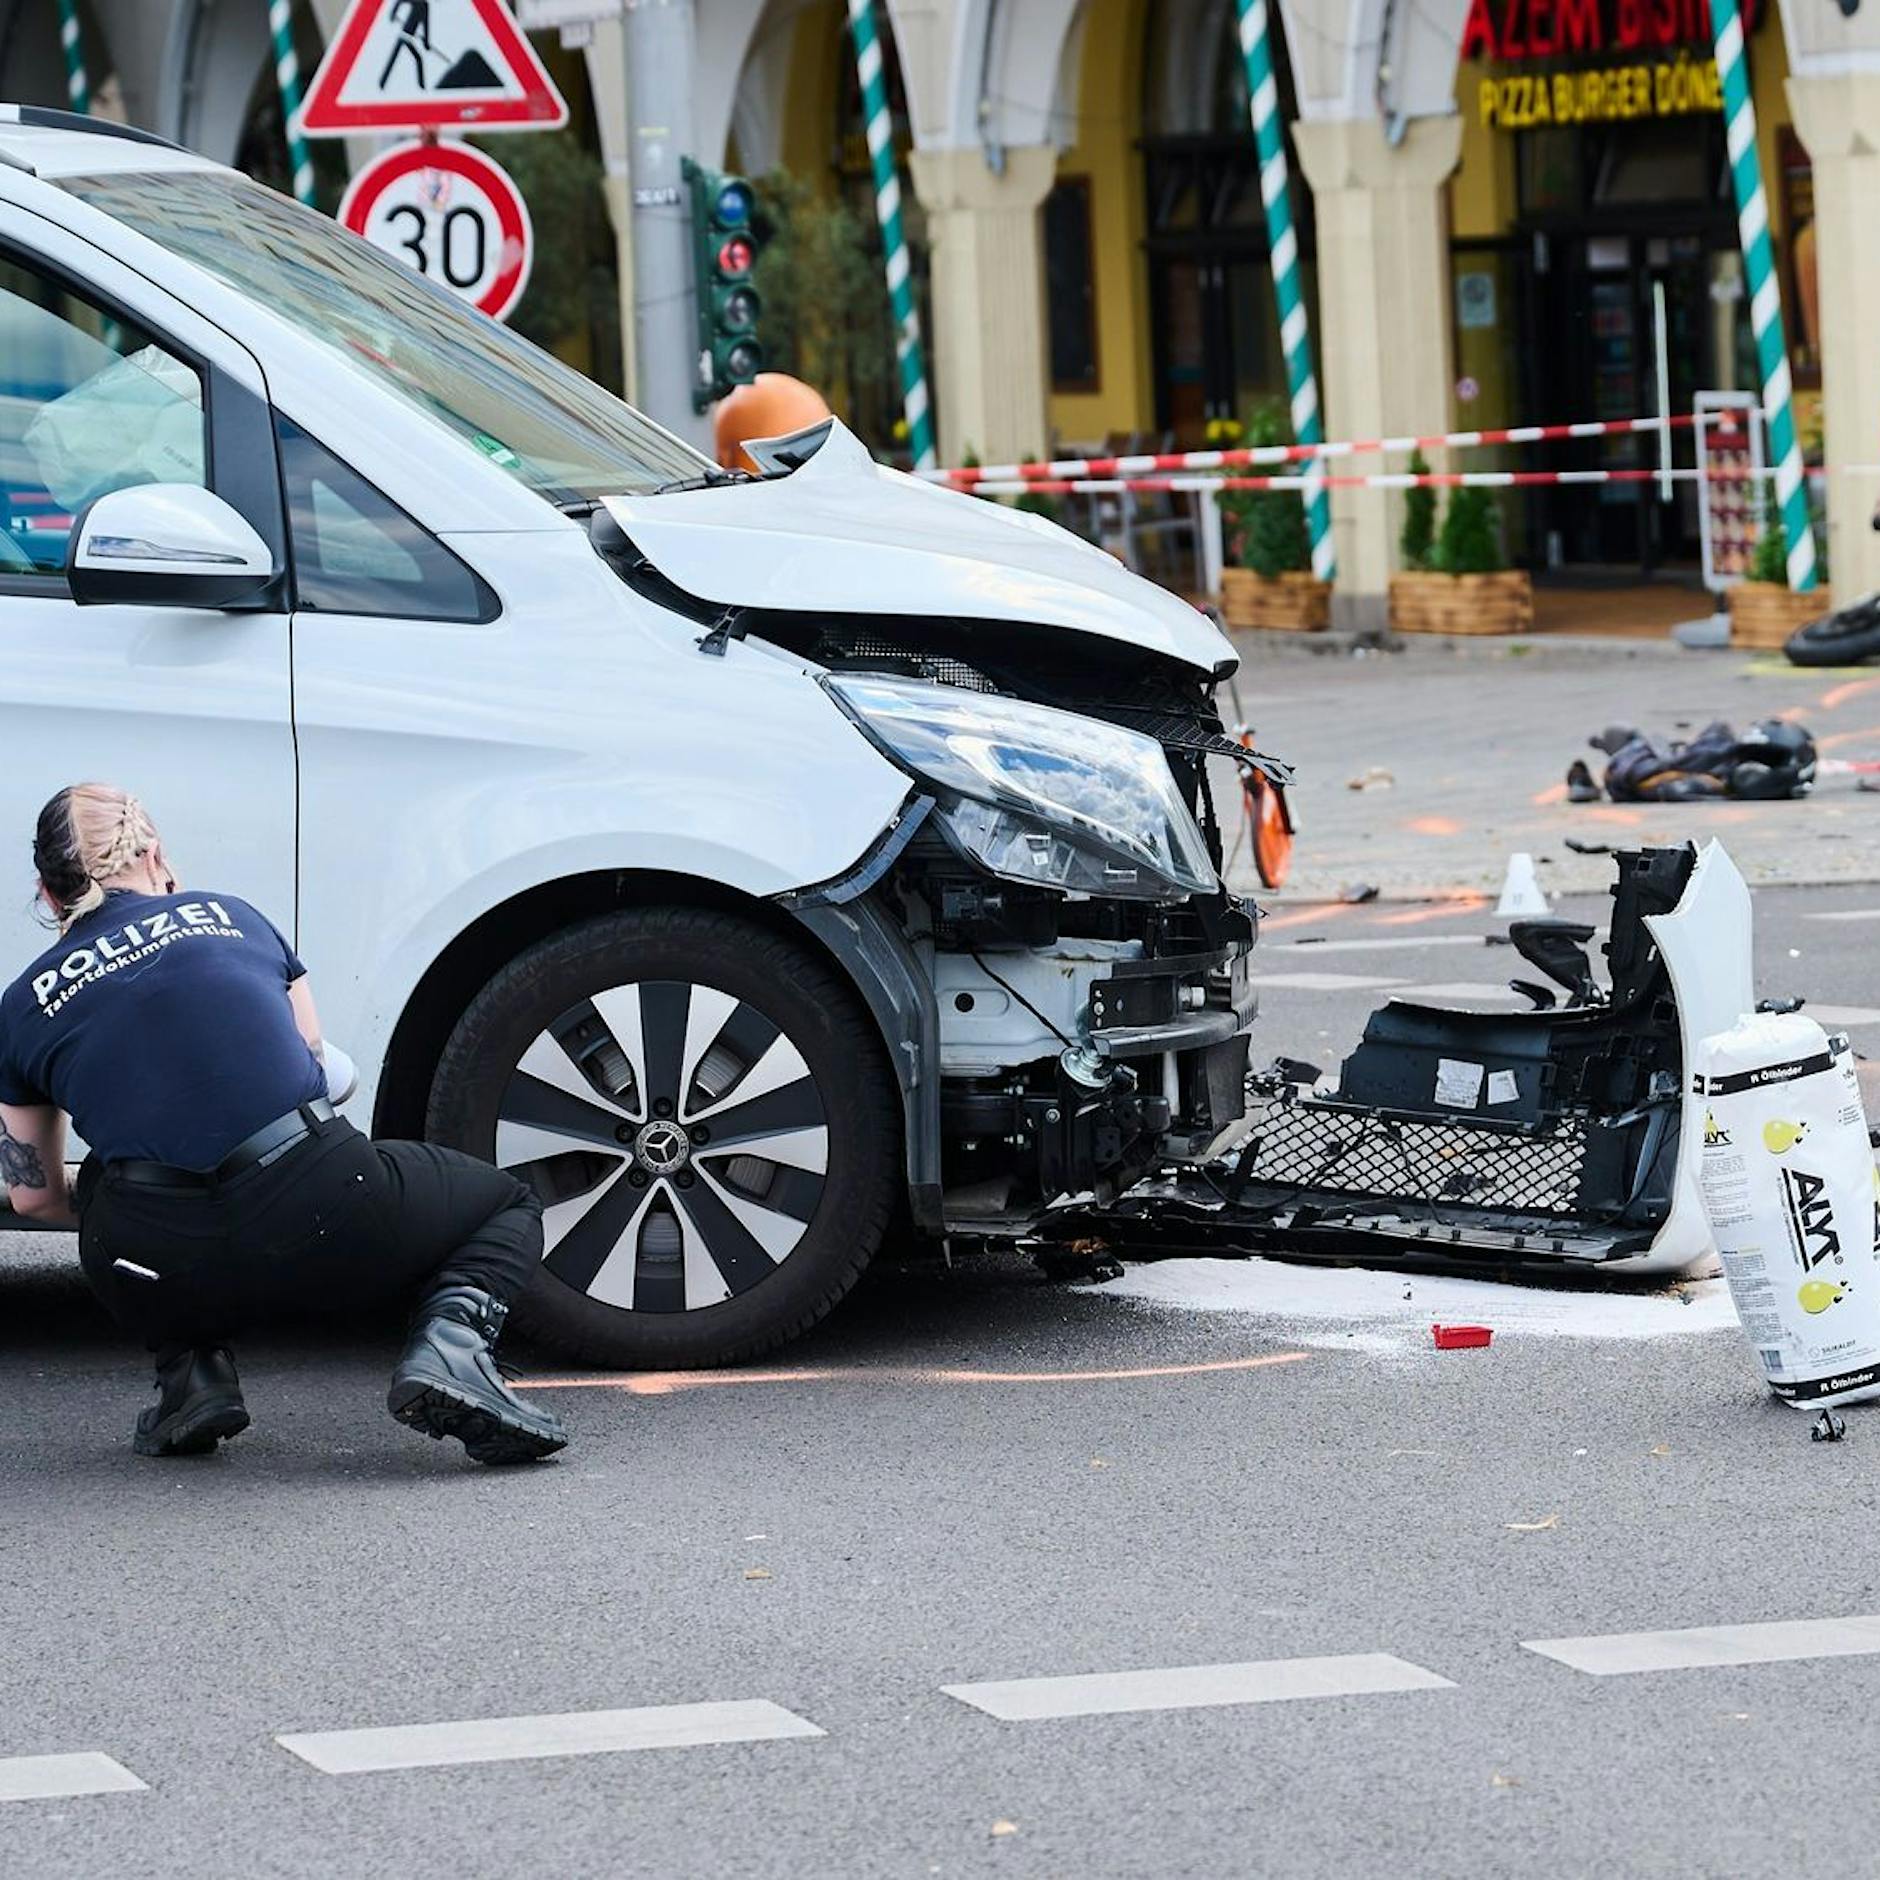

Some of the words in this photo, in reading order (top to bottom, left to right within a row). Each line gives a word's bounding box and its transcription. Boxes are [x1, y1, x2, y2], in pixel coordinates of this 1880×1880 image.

[1480, 78, 1551, 127] PIZZA
[1553, 70, 1651, 123] BURGER
[1655, 52, 1724, 113] DÖNE
[386, 204, 485, 288] 30
[32, 902, 232, 1006] POLIZEI
[43, 924, 244, 1018] Tatortdokumentation
[1761, 1066, 1803, 1081] Ölbinder
[1831, 1373, 1874, 1389] Ölbinder
